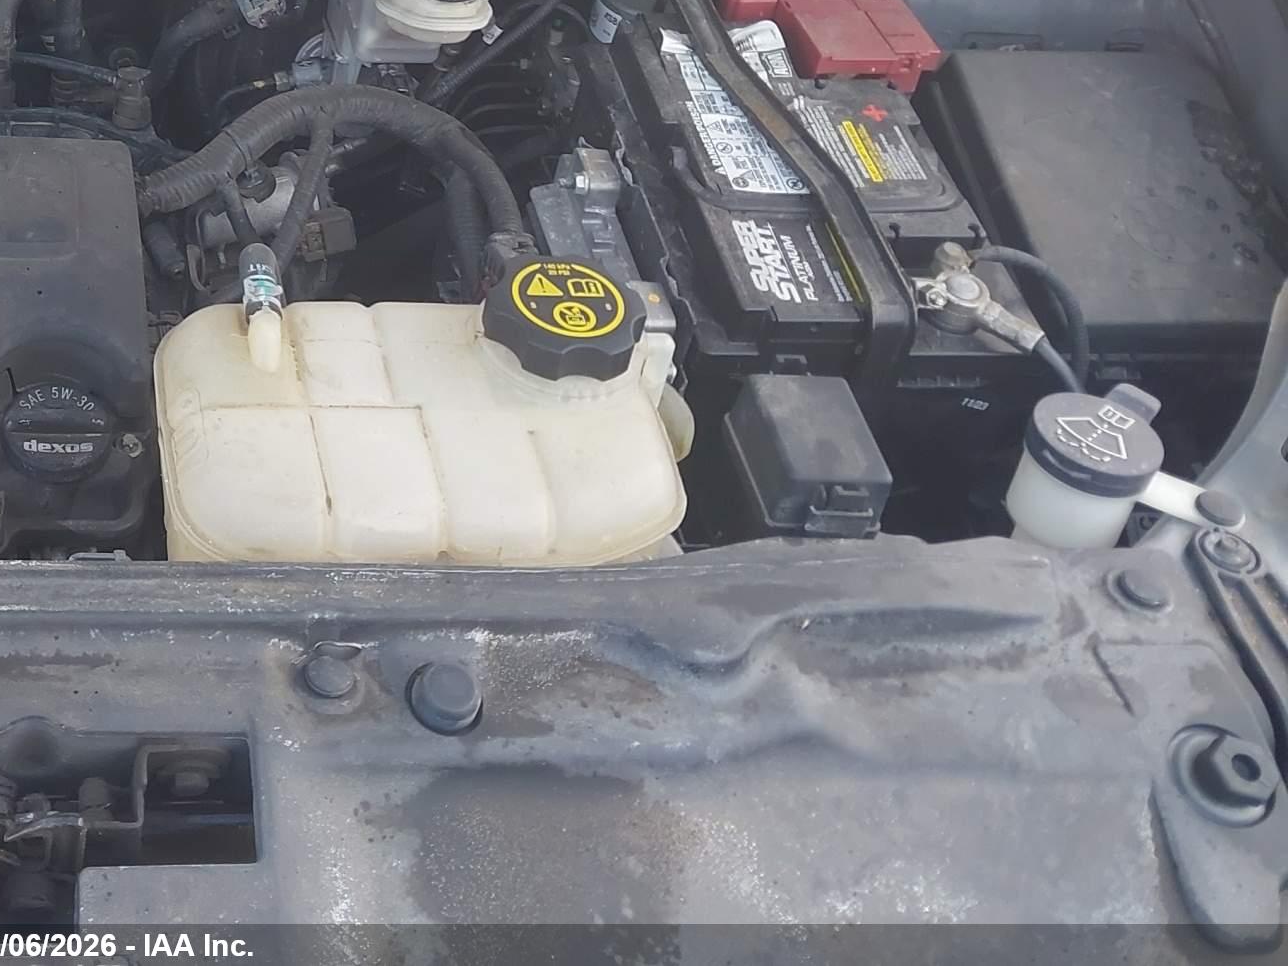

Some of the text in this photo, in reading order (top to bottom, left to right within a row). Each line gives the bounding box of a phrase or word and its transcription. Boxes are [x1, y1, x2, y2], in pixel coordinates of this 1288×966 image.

[732, 219, 769, 292] SUPER
[757, 226, 802, 303] START
[780, 234, 819, 301] PLATINUM
[19, 386, 95, 411] SAE 5W-30
[23, 439, 94, 454] dexos
